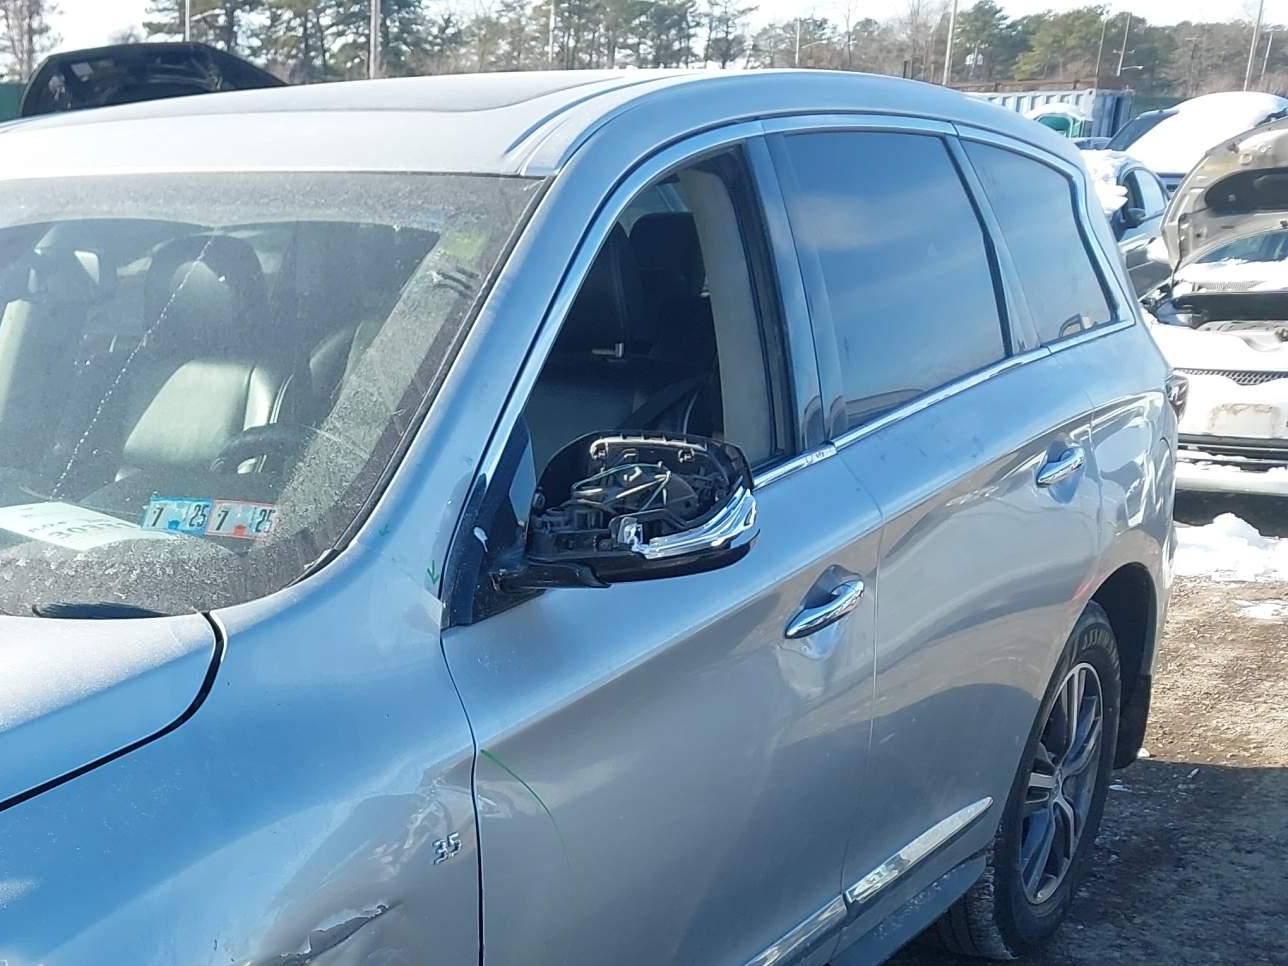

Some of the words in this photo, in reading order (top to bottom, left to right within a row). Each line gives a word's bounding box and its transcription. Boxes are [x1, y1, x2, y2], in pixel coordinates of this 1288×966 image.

[151, 507, 164, 527] 7
[189, 504, 209, 528] 25
[216, 510, 229, 531] 7
[255, 508, 276, 533] 25
